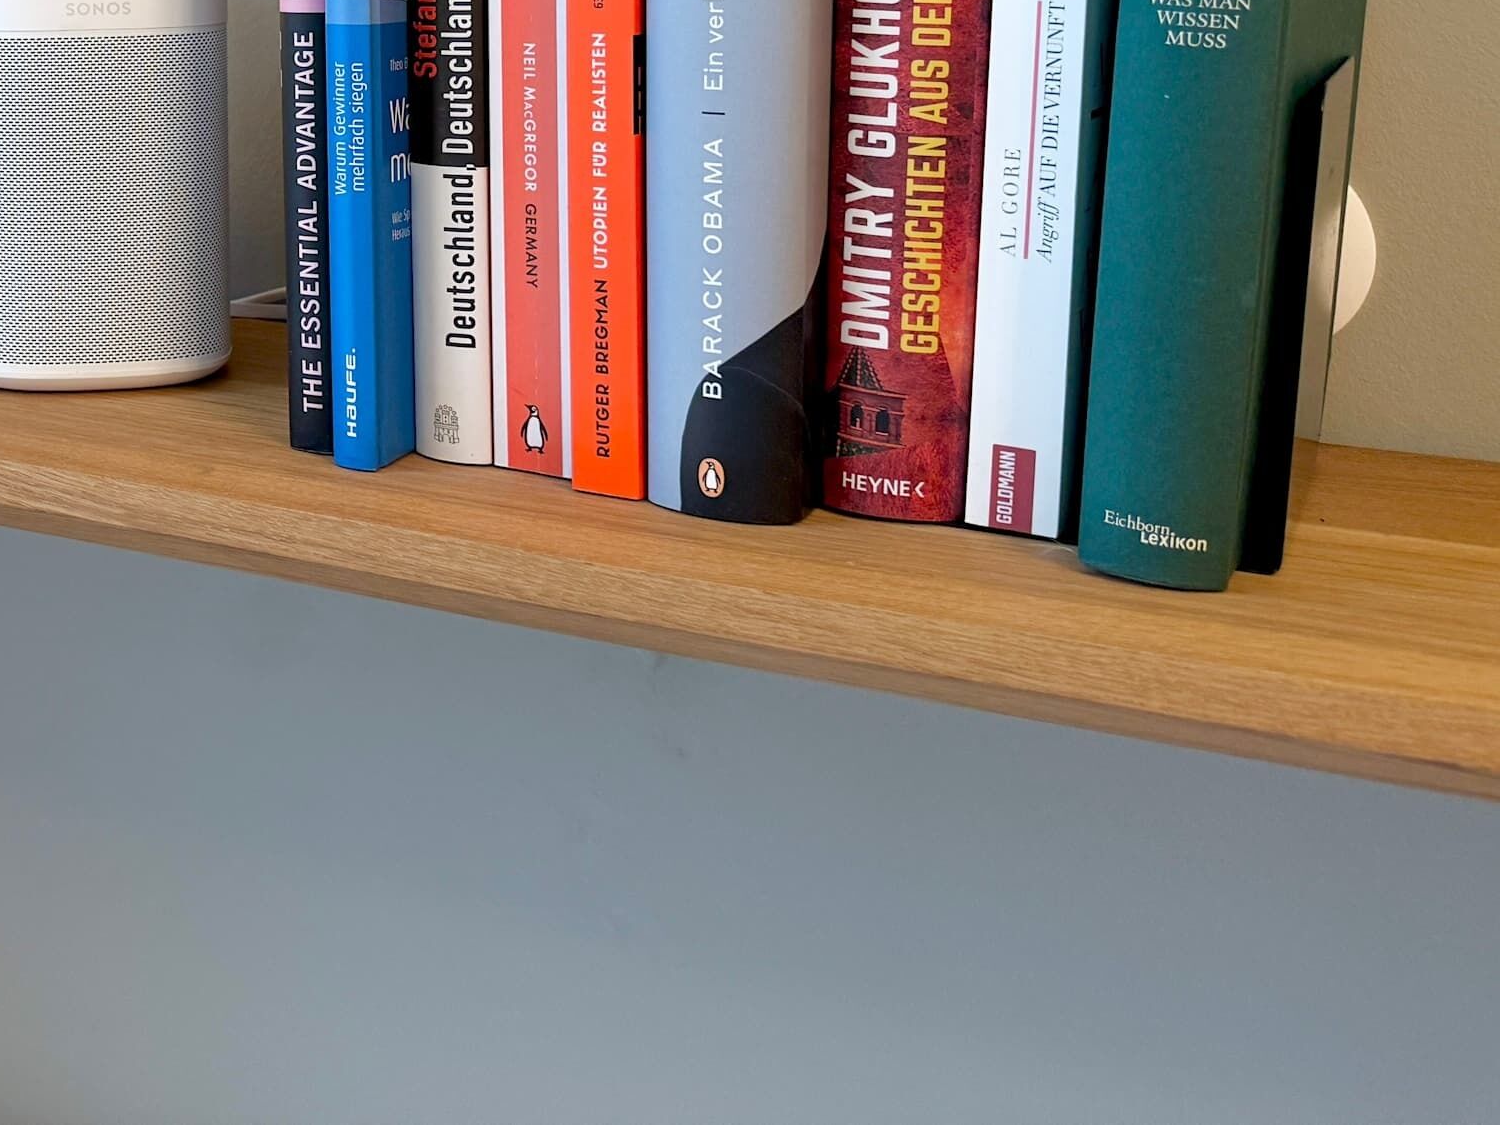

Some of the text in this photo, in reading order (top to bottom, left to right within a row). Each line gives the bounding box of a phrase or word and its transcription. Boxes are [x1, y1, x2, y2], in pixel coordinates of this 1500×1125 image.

[65, 1, 132, 16] SONOS
[523, 42, 536, 79] NEIL
[1156, 10, 1241, 30] WISSEN
[1164, 30, 1228, 49] MUSS
[352, 62, 368, 192] mehrfach siegen
[703, 52, 724, 91] Ein
[909, 59, 951, 125] AUS
[333, 61, 346, 196] Warum Gewinner
[1035, 1, 1066, 264] Angriff AUF DIE VERNUNFT
[293, 31, 324, 413] THE ESSENTIAL ADVANTAGE
[524, 203, 539, 288] GERMANY
[591, 33, 610, 459] RUTGER BREGMAN UTOPIEN FÜR REALISTEN
[702, 138, 723, 255] OBAMA
[900, 135, 948, 355] GESCHICHTEN
[999, 147, 1021, 258] AL GORE
[442, 163, 477, 349] Deutschland,
[840, 173, 895, 351] DMITRY
[702, 268, 723, 400] BARACK
[996, 450, 1016, 525] GOLDMANN
[1103, 509, 1171, 536] Eichborn
[1140, 531, 1208, 552] Lexikon
